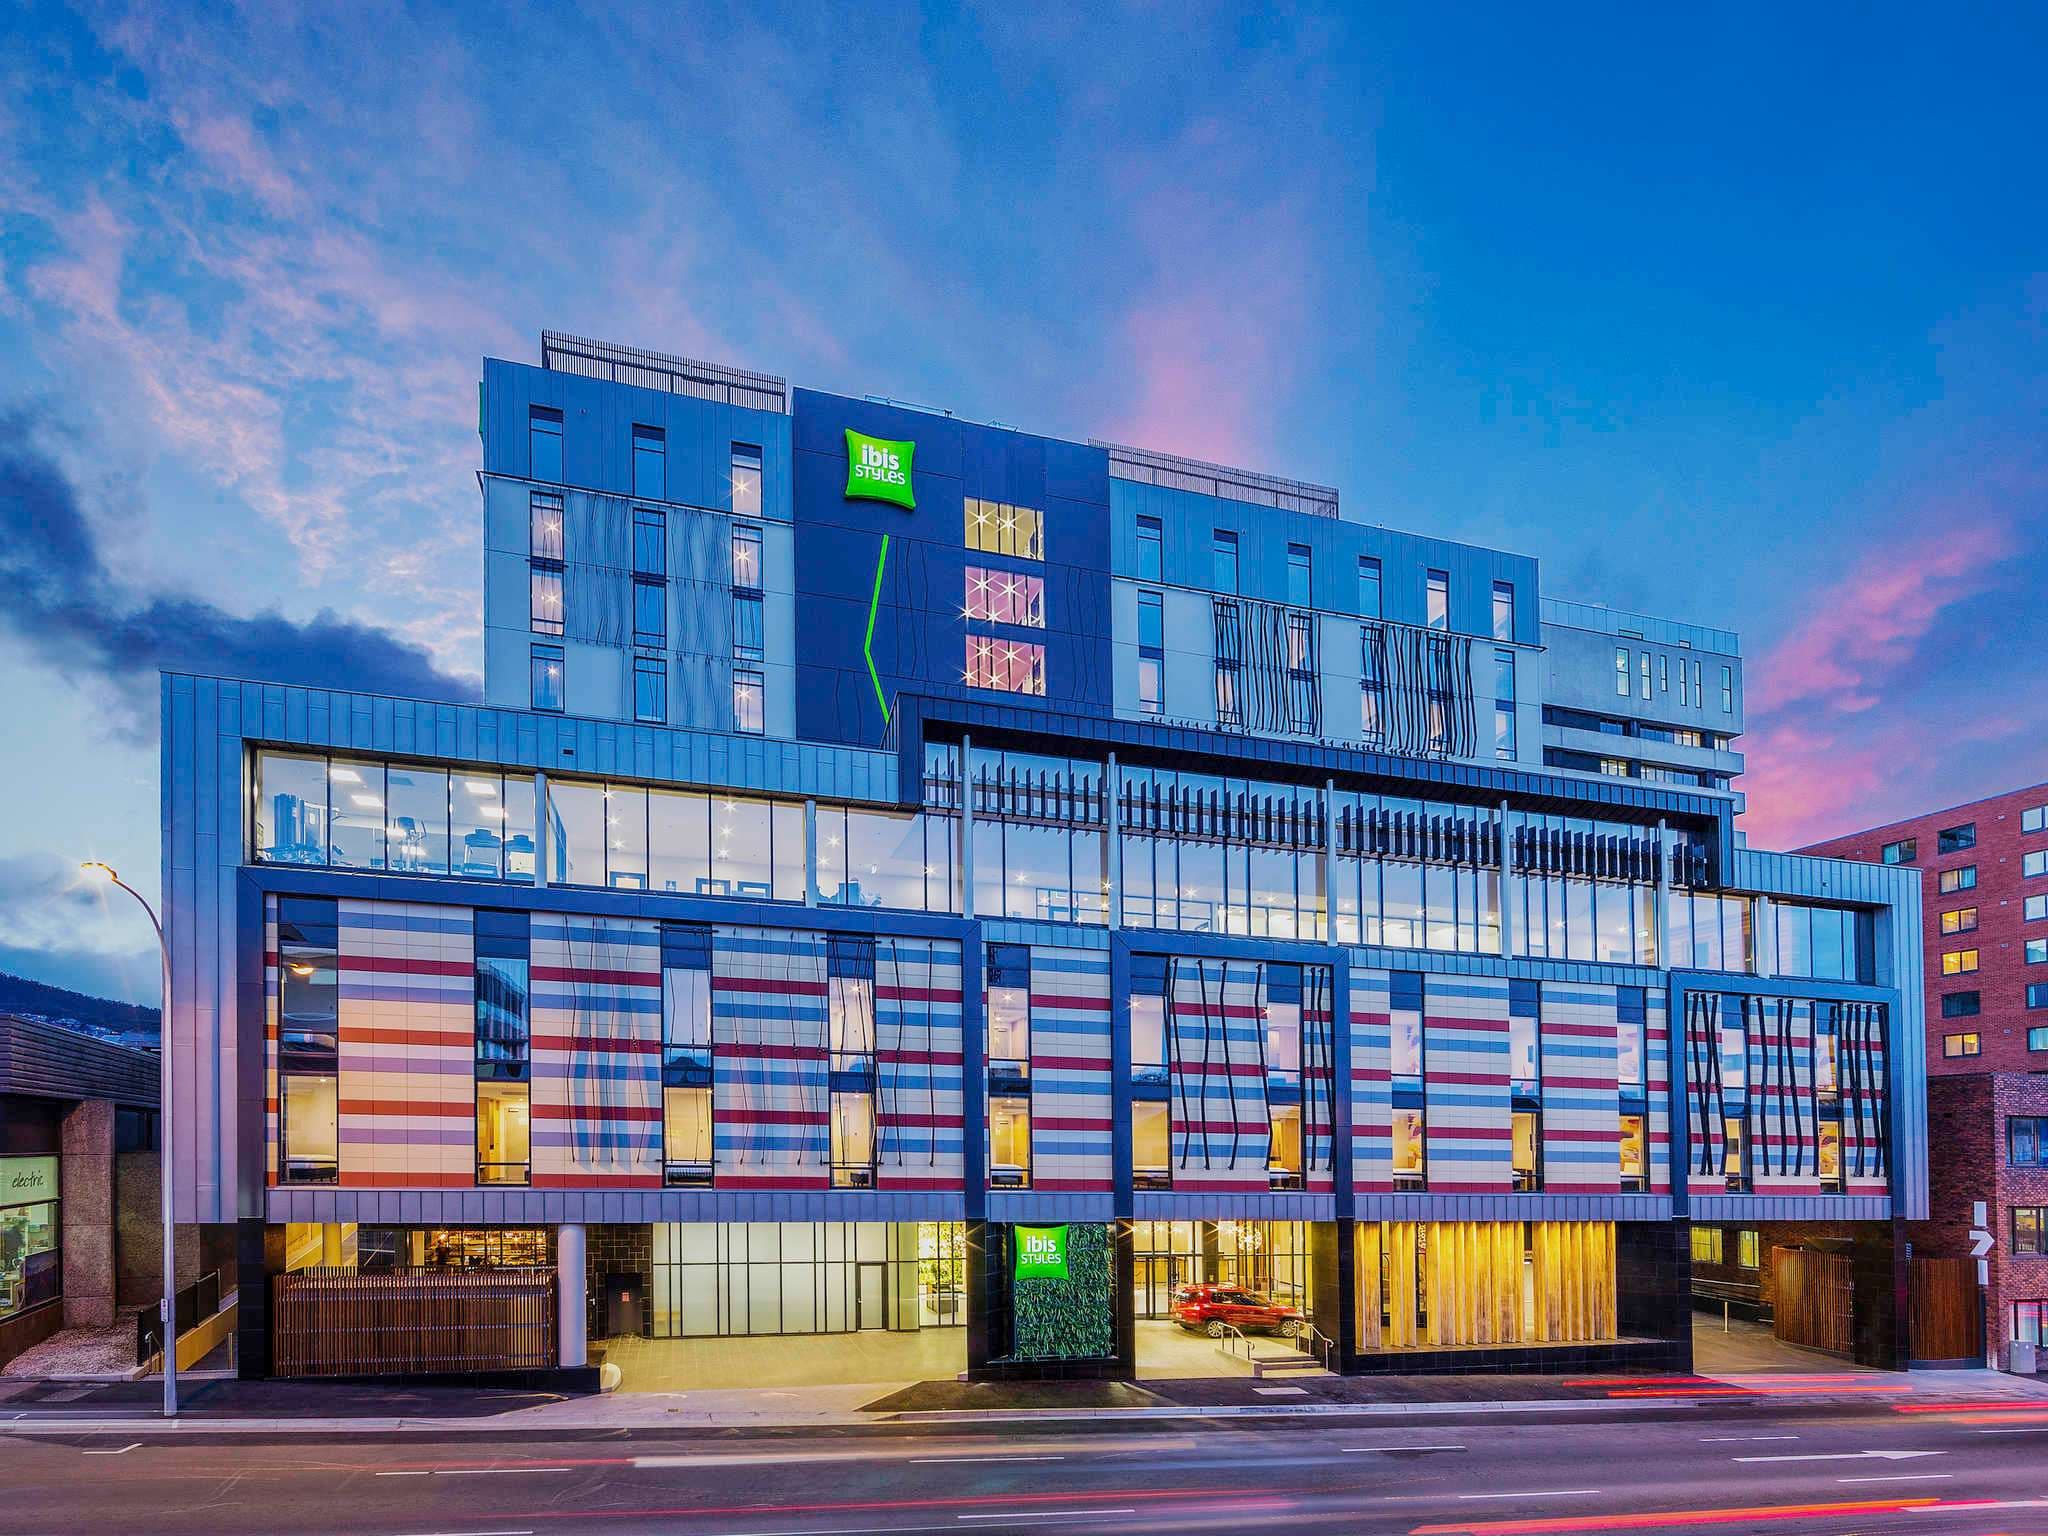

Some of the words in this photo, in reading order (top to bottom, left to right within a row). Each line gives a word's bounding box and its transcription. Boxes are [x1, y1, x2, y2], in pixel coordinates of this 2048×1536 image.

[862, 444, 900, 470] ibis
[12, 1170, 44, 1188] electric
[1026, 1235, 1057, 1253] ibis
